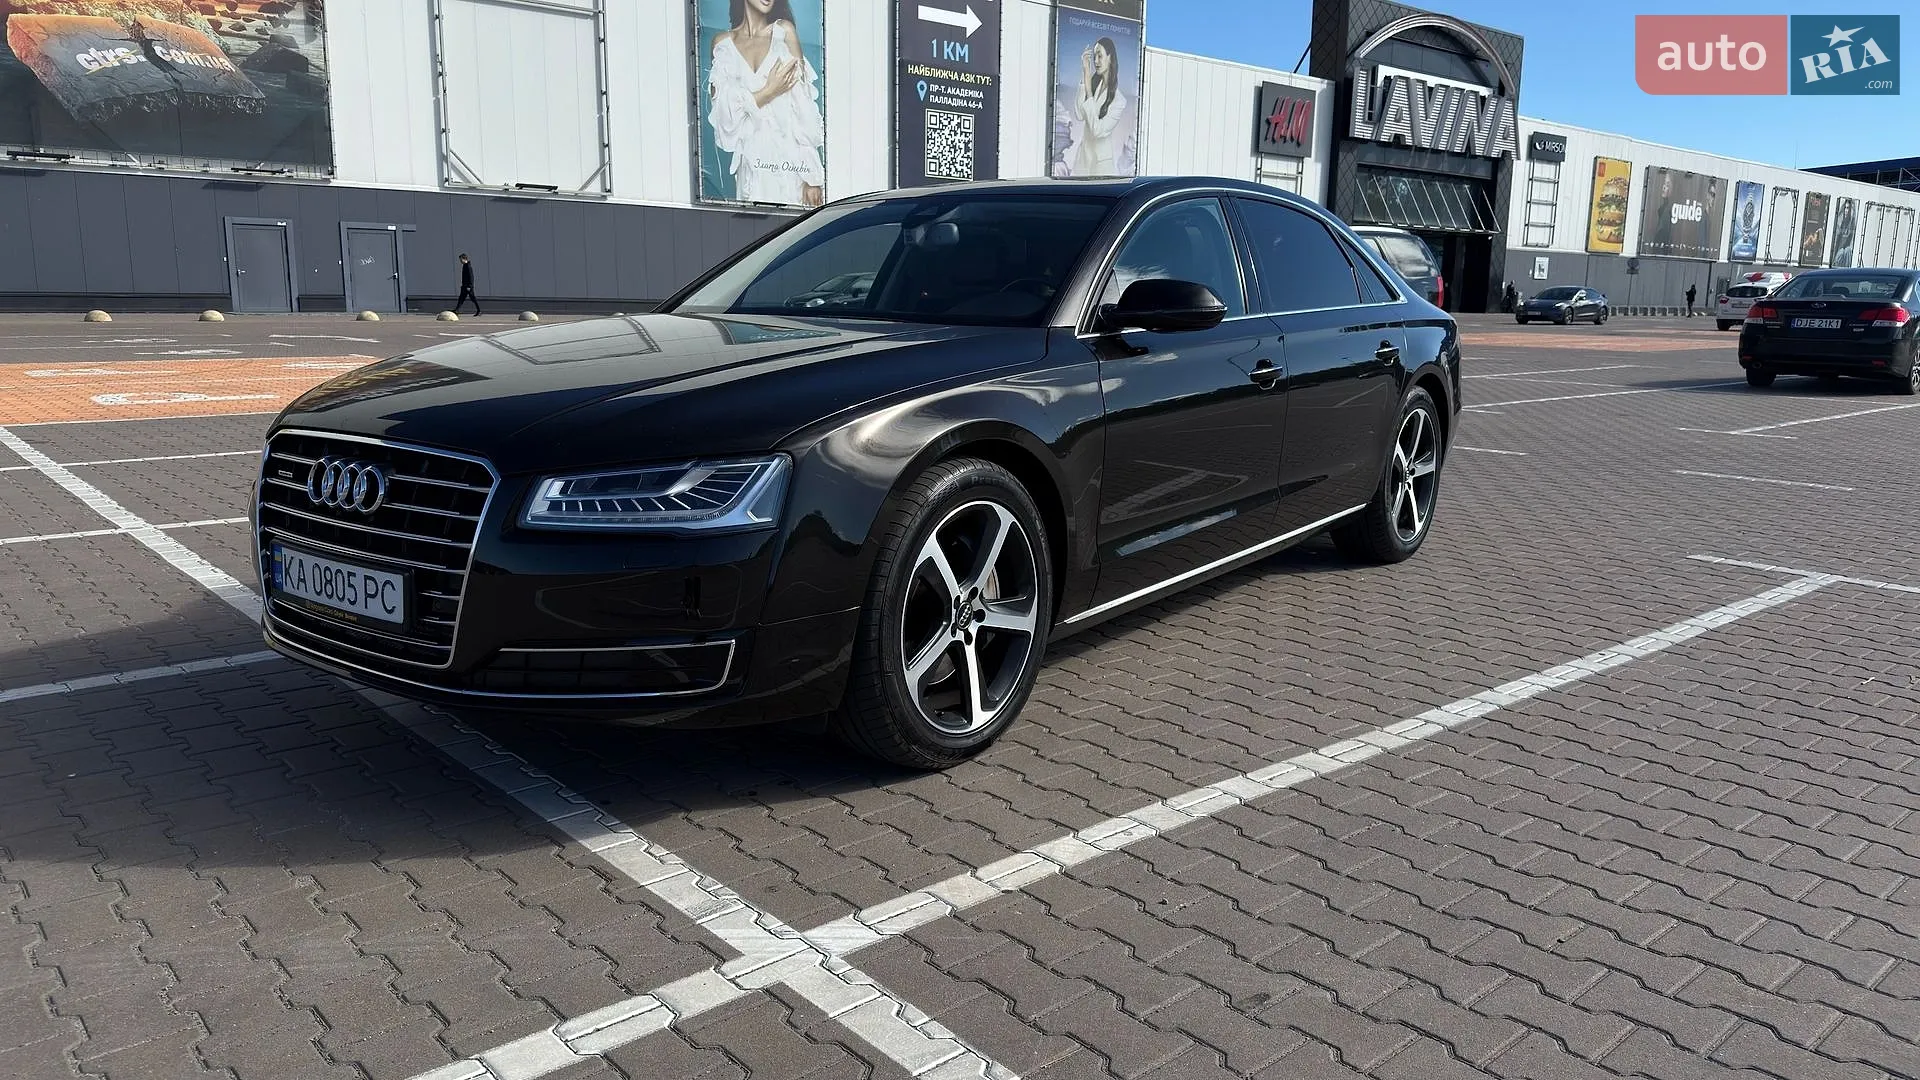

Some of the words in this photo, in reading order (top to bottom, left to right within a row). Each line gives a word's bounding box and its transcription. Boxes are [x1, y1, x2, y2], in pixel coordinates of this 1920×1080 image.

[931, 38, 937, 58] 1
[943, 40, 969, 63] КМ
[907, 63, 959, 82] НАЙБЛИЖЧА
[960, 72, 976, 84] АЗК
[976, 75, 992, 86] ТУТ:
[929, 83, 947, 93] ПР-Т.
[947, 86, 984, 99] АКАДЕМІКА
[929, 94, 968, 107] ПАЛЛАДІНА
[1267, 95, 1312, 145] H&M
[1350, 67, 1521, 160] LAVINA
[1796, 318, 1816, 327] DJE
[283, 553, 309, 593] KA
[312, 562, 358, 606] 0805
[363, 574, 397, 615] PC
